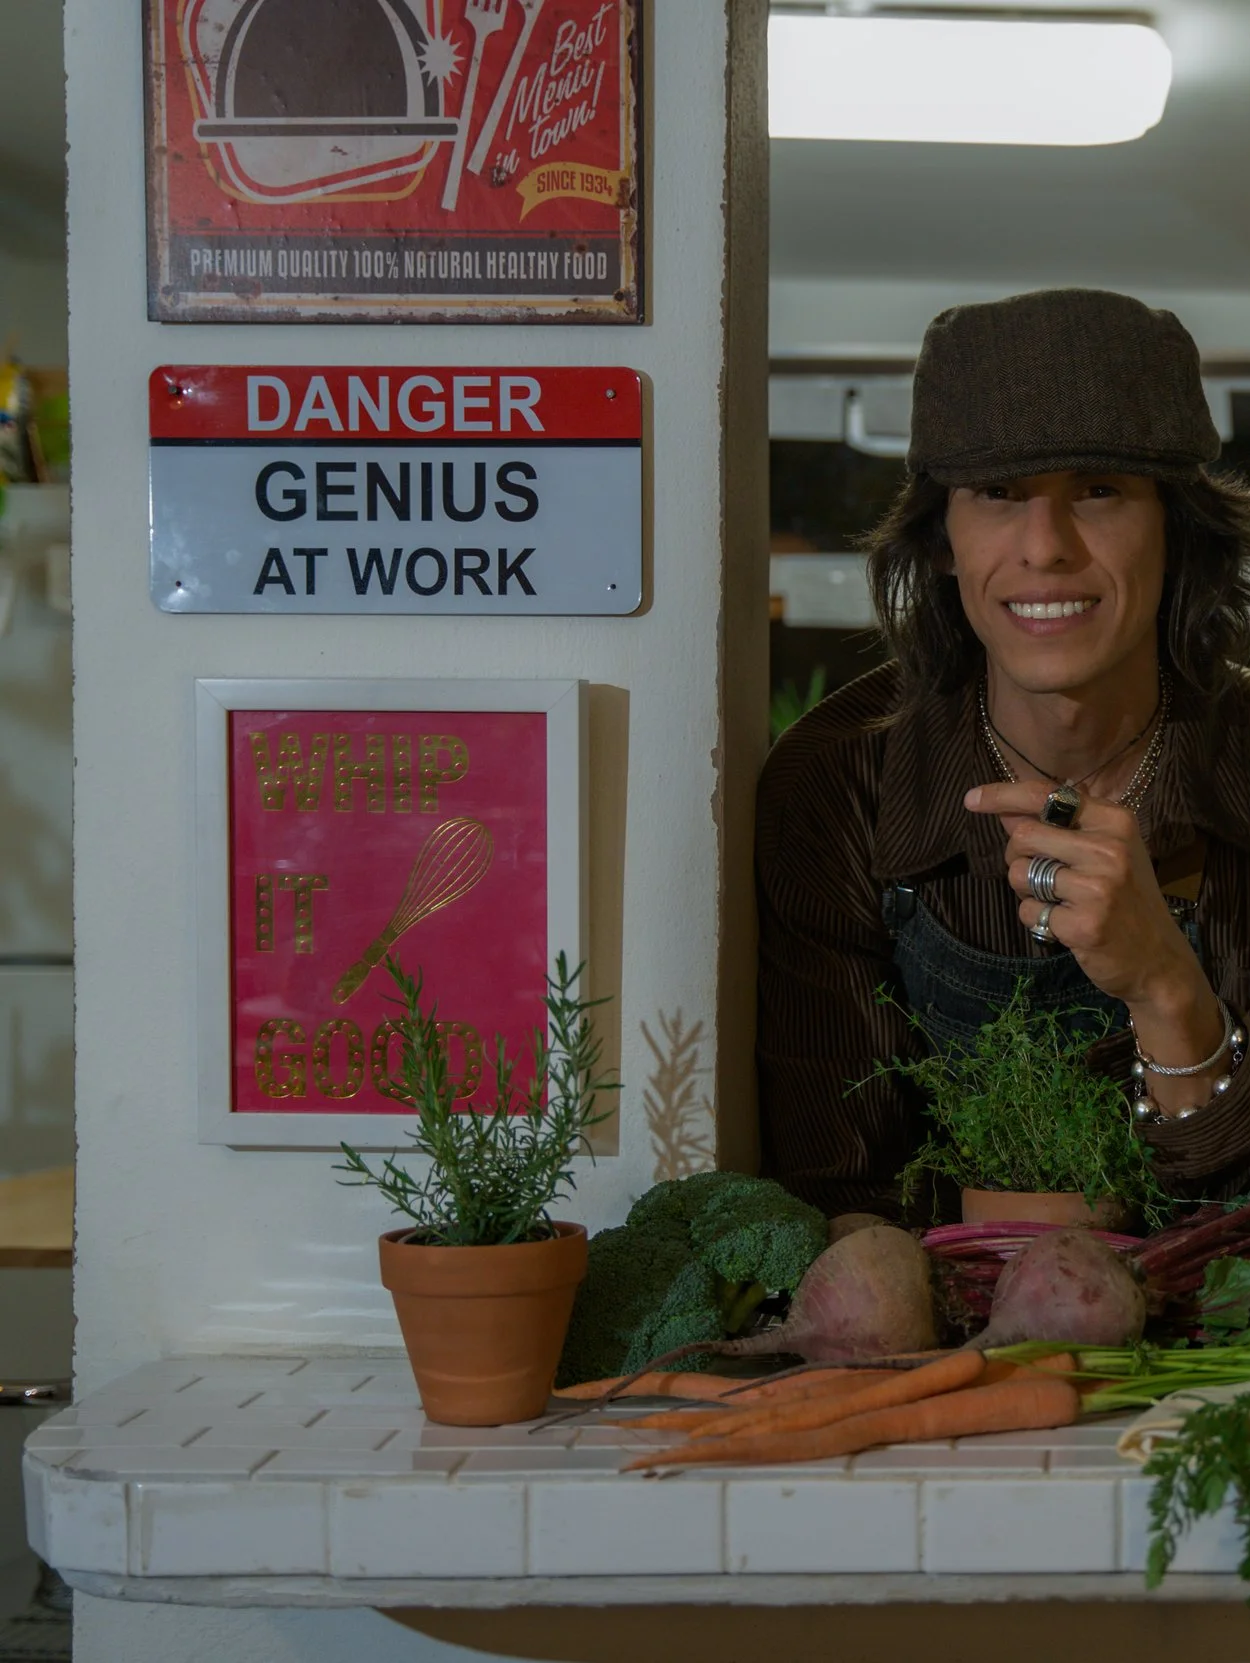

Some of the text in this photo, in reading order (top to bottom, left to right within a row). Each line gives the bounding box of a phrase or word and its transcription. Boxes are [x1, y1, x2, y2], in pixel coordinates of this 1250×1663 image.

[551, 3, 613, 76] Best
[506, 60, 594, 140] Menu
[536, 172, 613, 196] SINCE 1934
[190, 248, 608, 281] PREMIUM QUALITY 100% NATURAL HEALTHY FOOD
[246, 375, 546, 432] DANGER
[254, 461, 540, 523] GENIUS
[252, 547, 538, 596] AT WORK
[249, 731, 470, 815] WHIP
[255, 873, 329, 954] IT
